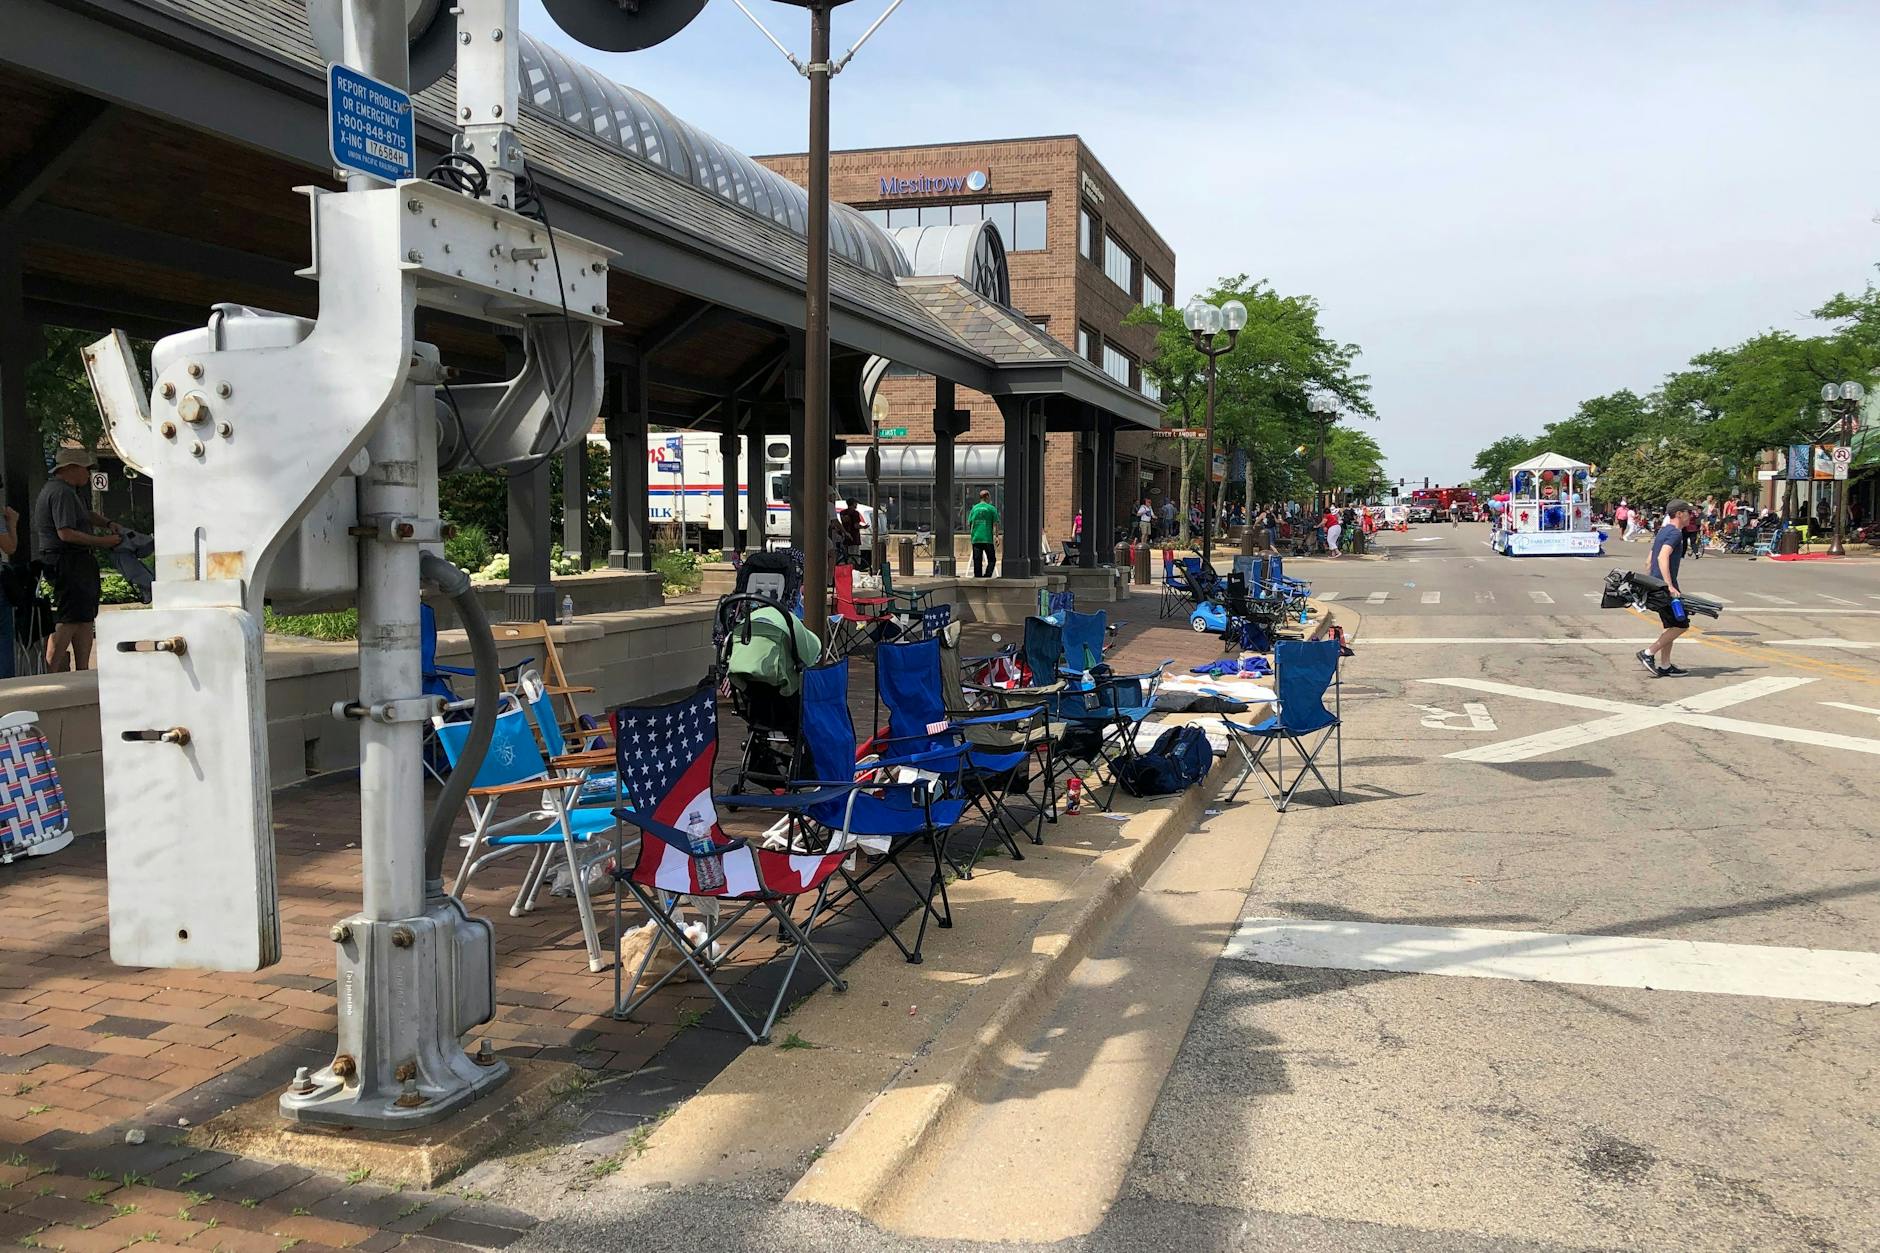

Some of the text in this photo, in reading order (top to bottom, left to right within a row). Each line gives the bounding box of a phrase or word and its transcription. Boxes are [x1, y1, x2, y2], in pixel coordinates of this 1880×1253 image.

[337, 76, 367, 100] REPORT
[342, 96, 400, 130] OR EMERGENCY
[337, 111, 406, 149] 1-800-848-8715
[340, 130, 404, 164] X-ING 176584H
[347, 150, 399, 174] UNION PACIFIC RAILROAD
[879, 173, 966, 195] Mesirow
[649, 508, 672, 518] ILK
